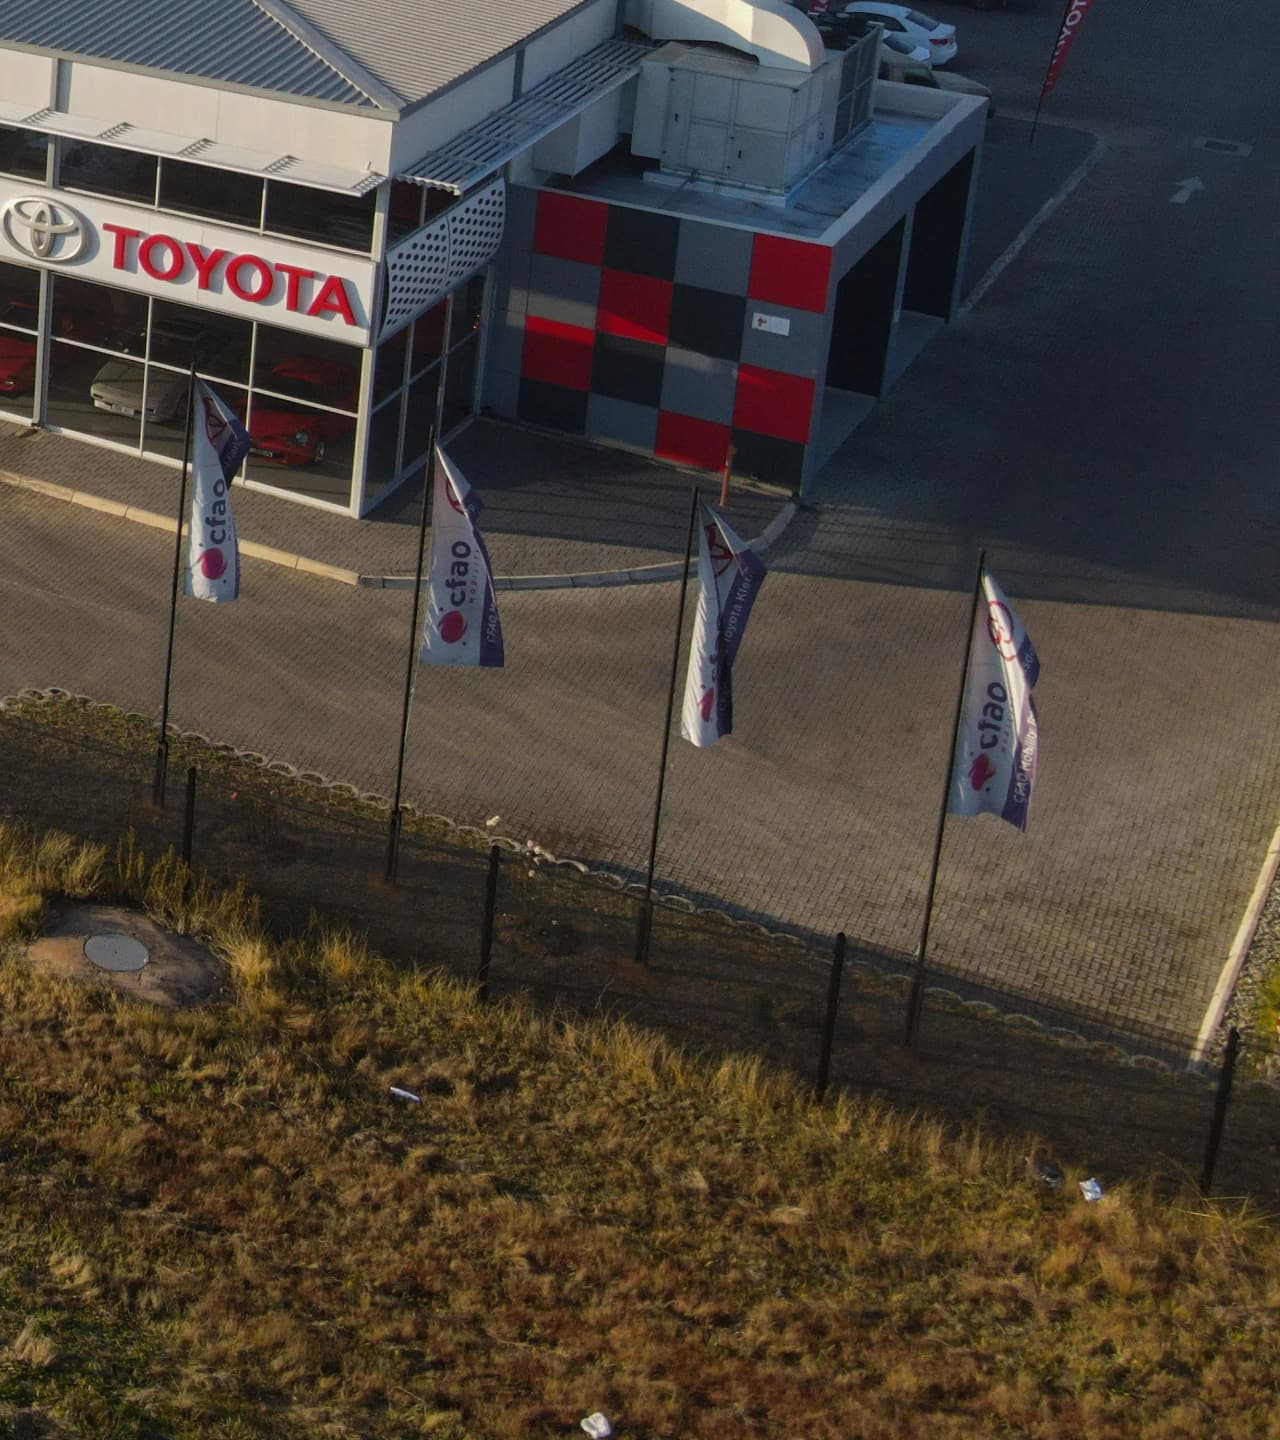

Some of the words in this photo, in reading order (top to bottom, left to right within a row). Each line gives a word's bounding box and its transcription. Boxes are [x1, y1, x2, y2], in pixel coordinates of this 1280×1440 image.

[102, 223, 357, 326] TOYOTA
[204, 478, 226, 545] cfao
[445, 540, 472, 607] cfao
